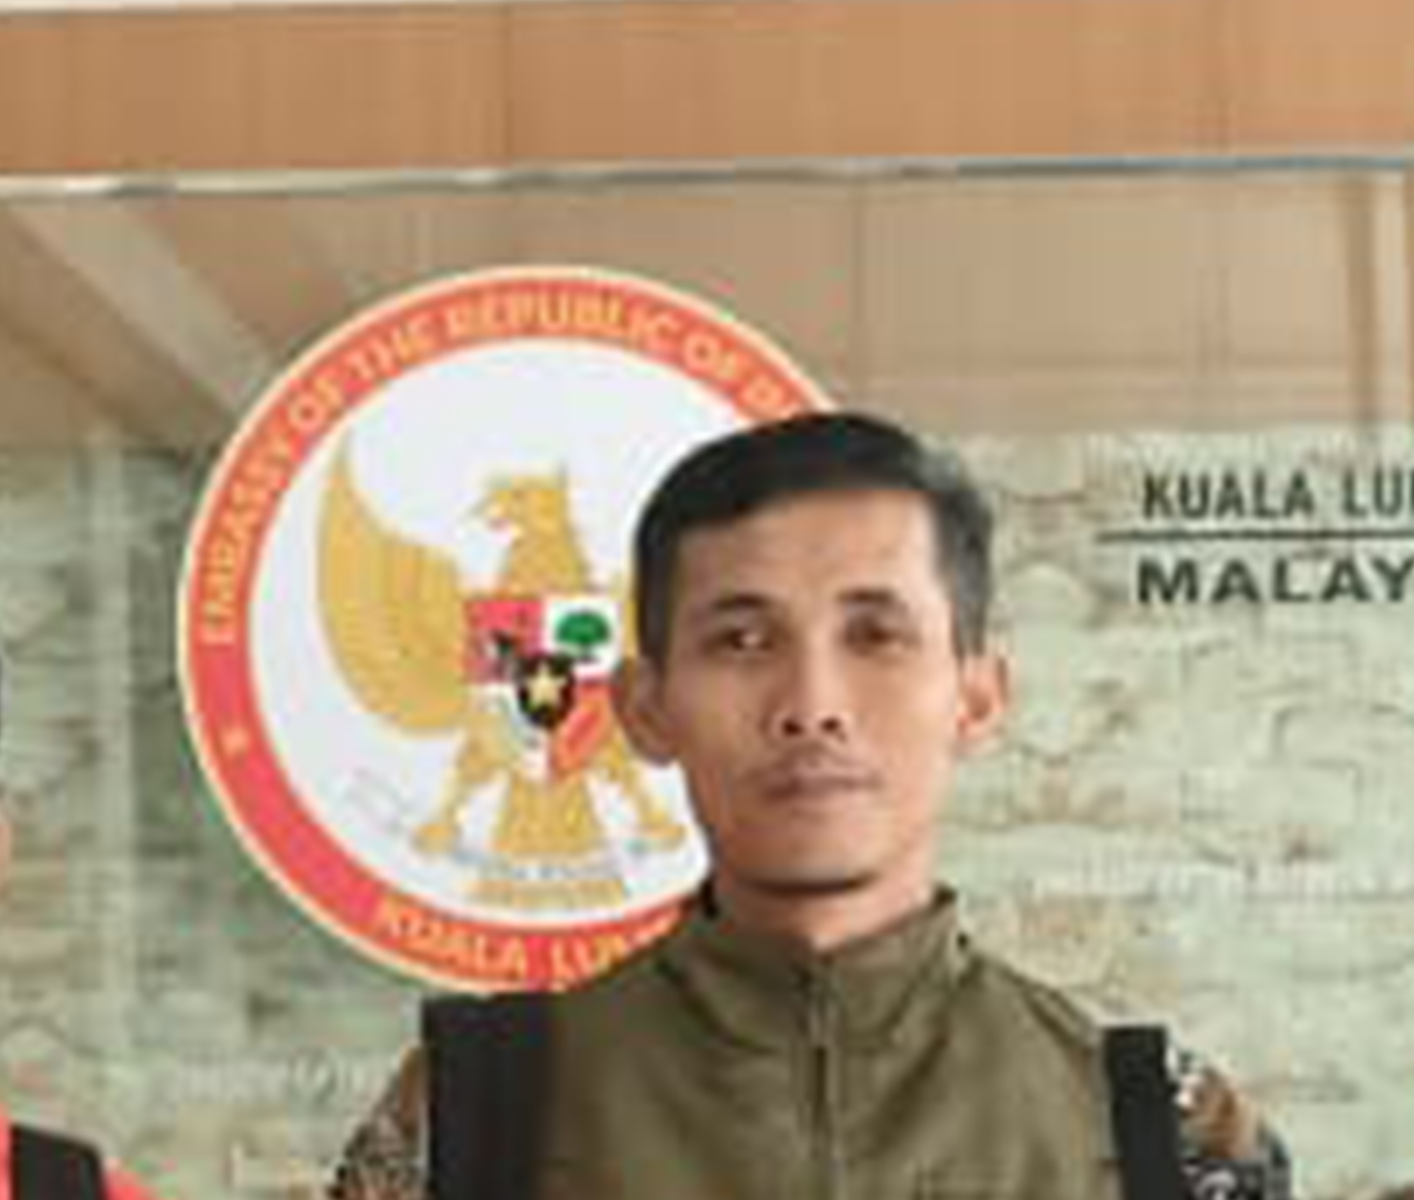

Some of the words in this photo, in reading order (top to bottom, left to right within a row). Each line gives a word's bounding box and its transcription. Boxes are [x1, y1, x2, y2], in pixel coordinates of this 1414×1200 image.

[197, 426, 293, 646] EMBASSY
[286, 370, 347, 435] OF
[343, 312, 439, 382] THE
[446, 290, 682, 349] REPUBLIC
[683, 327, 749, 382] OF
[1141, 469, 1315, 521] KUALA
[379, 891, 527, 980] KUALA
